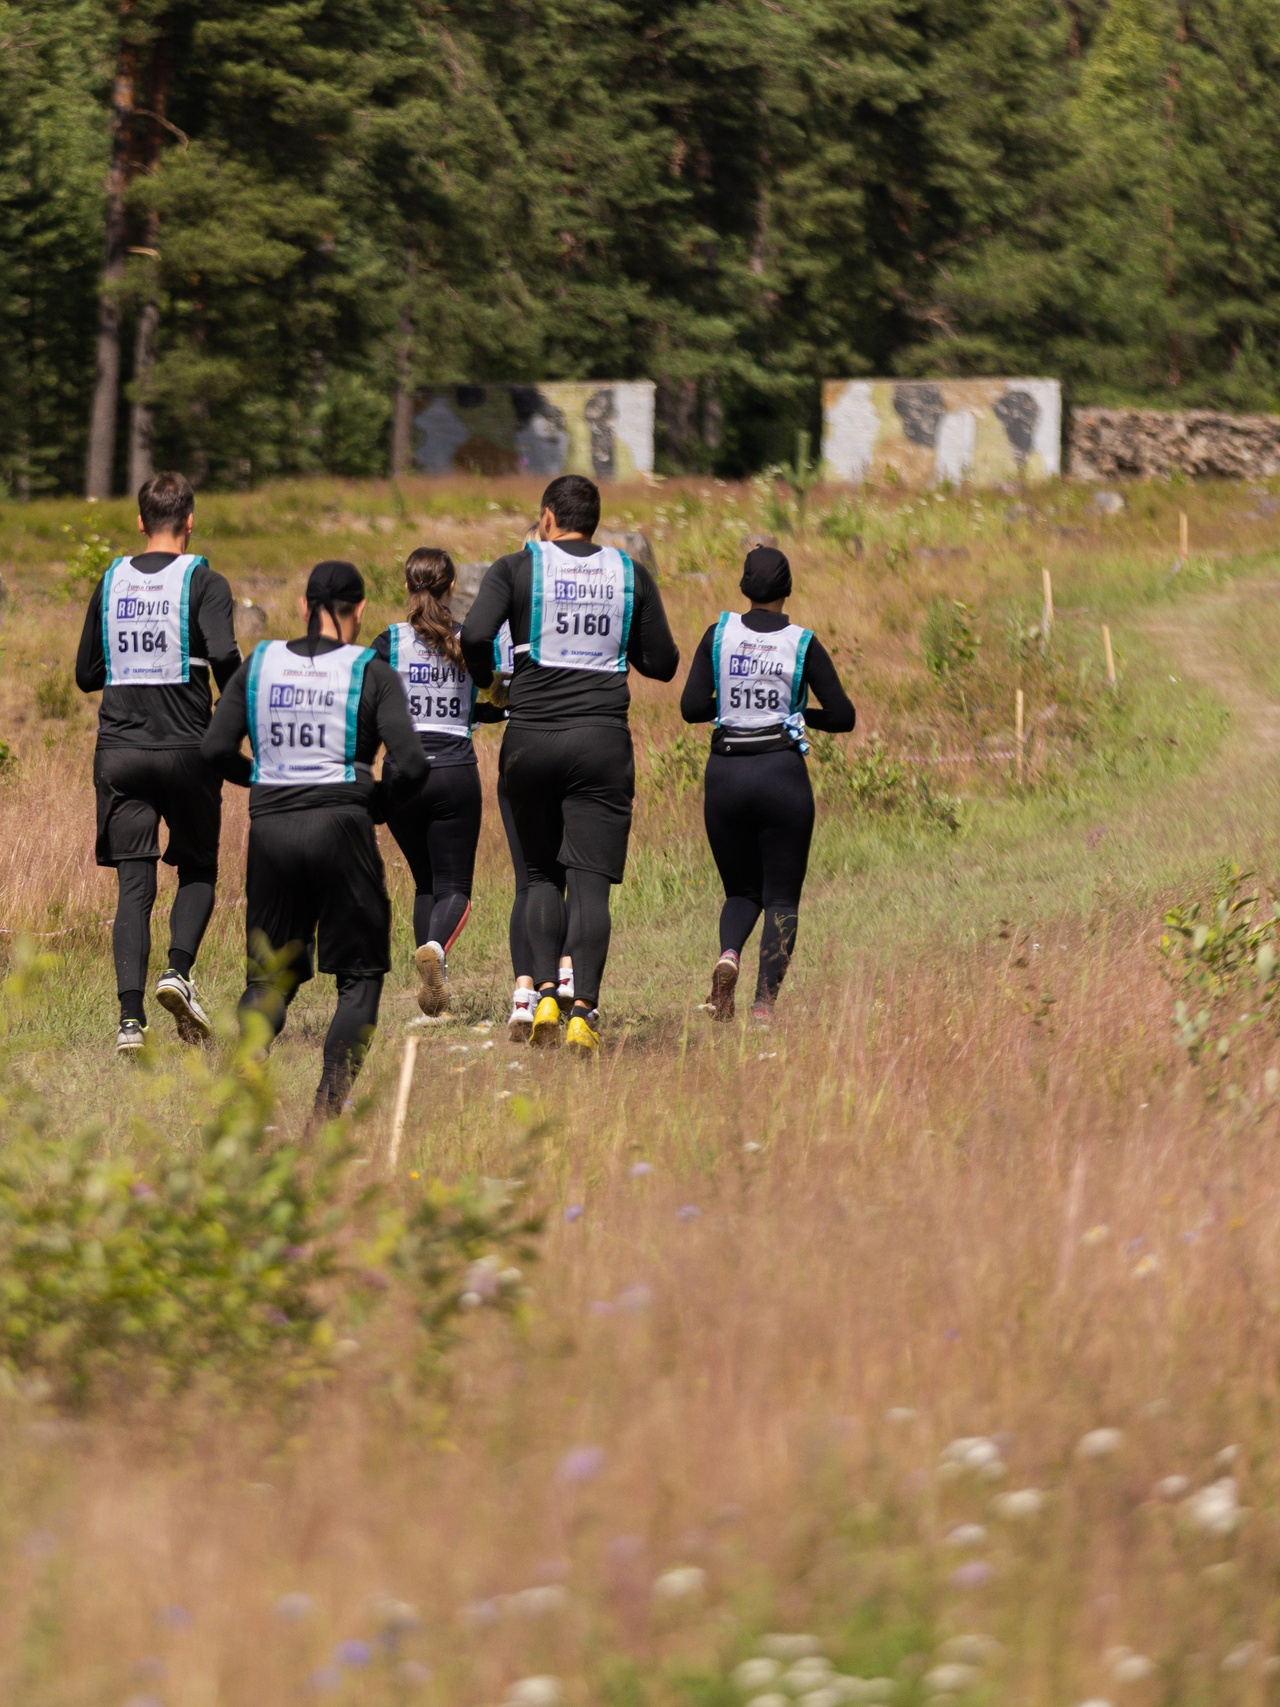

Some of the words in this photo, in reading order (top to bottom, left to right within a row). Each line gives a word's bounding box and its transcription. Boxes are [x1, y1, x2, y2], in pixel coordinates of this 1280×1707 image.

[555, 580, 614, 601] RODVIG
[117, 598, 170, 619] RODVIG
[556, 612, 611, 636] 5160
[118, 630, 168, 653] 5164
[410, 664, 465, 684] RODVIG
[729, 655, 783, 676] RODVIG
[270, 684, 335, 708] RODVIG
[410, 695, 461, 718] 5159
[730, 688, 780, 709] 5158
[271, 722, 326, 748] 5161
